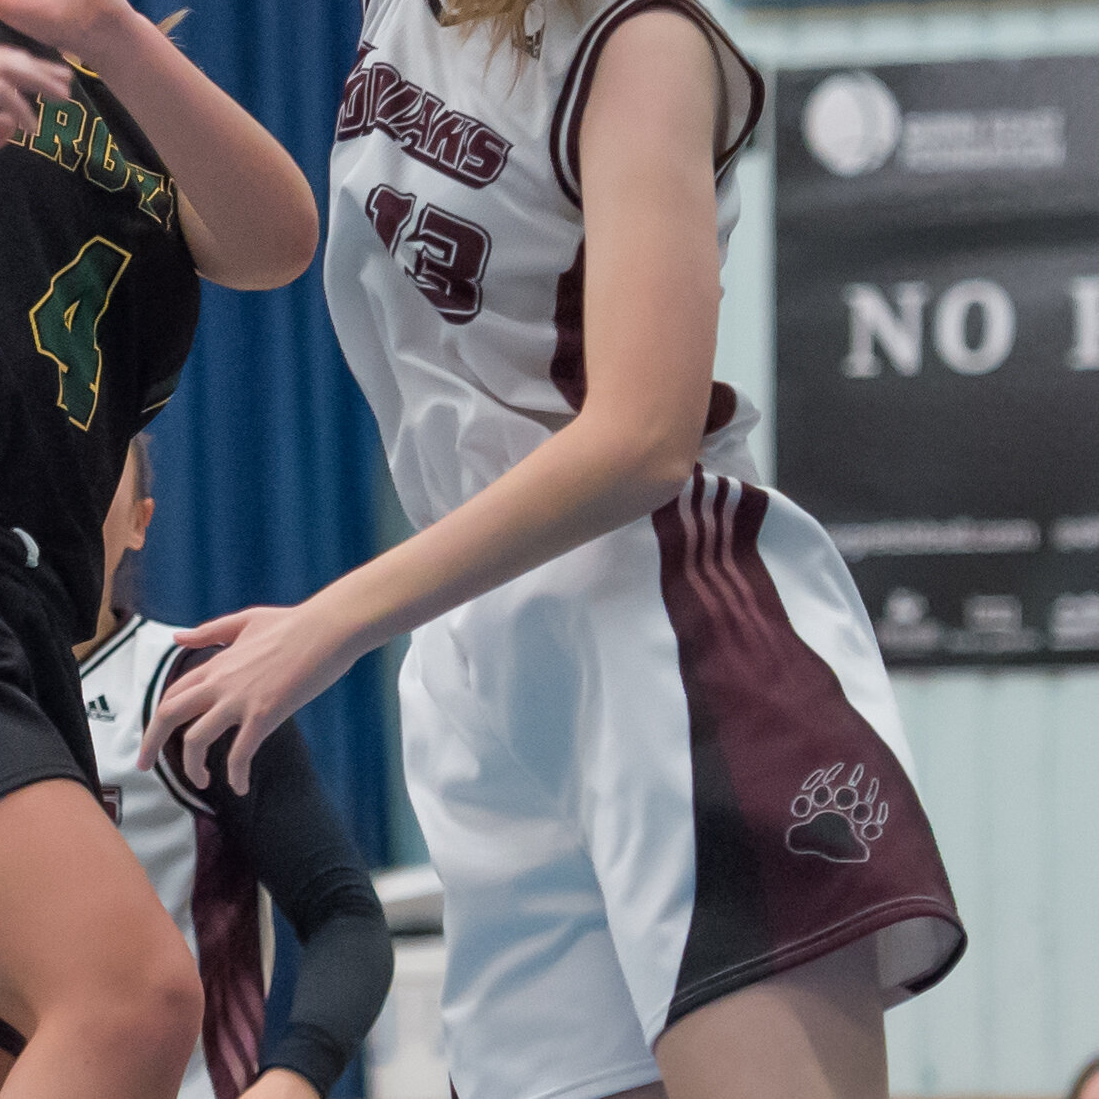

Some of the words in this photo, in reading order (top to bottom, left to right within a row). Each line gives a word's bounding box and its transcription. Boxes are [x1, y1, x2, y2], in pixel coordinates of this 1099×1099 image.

[365, 183, 492, 325] 13
[29, 235, 132, 432] 4
[842, 279, 1017, 379] NO
